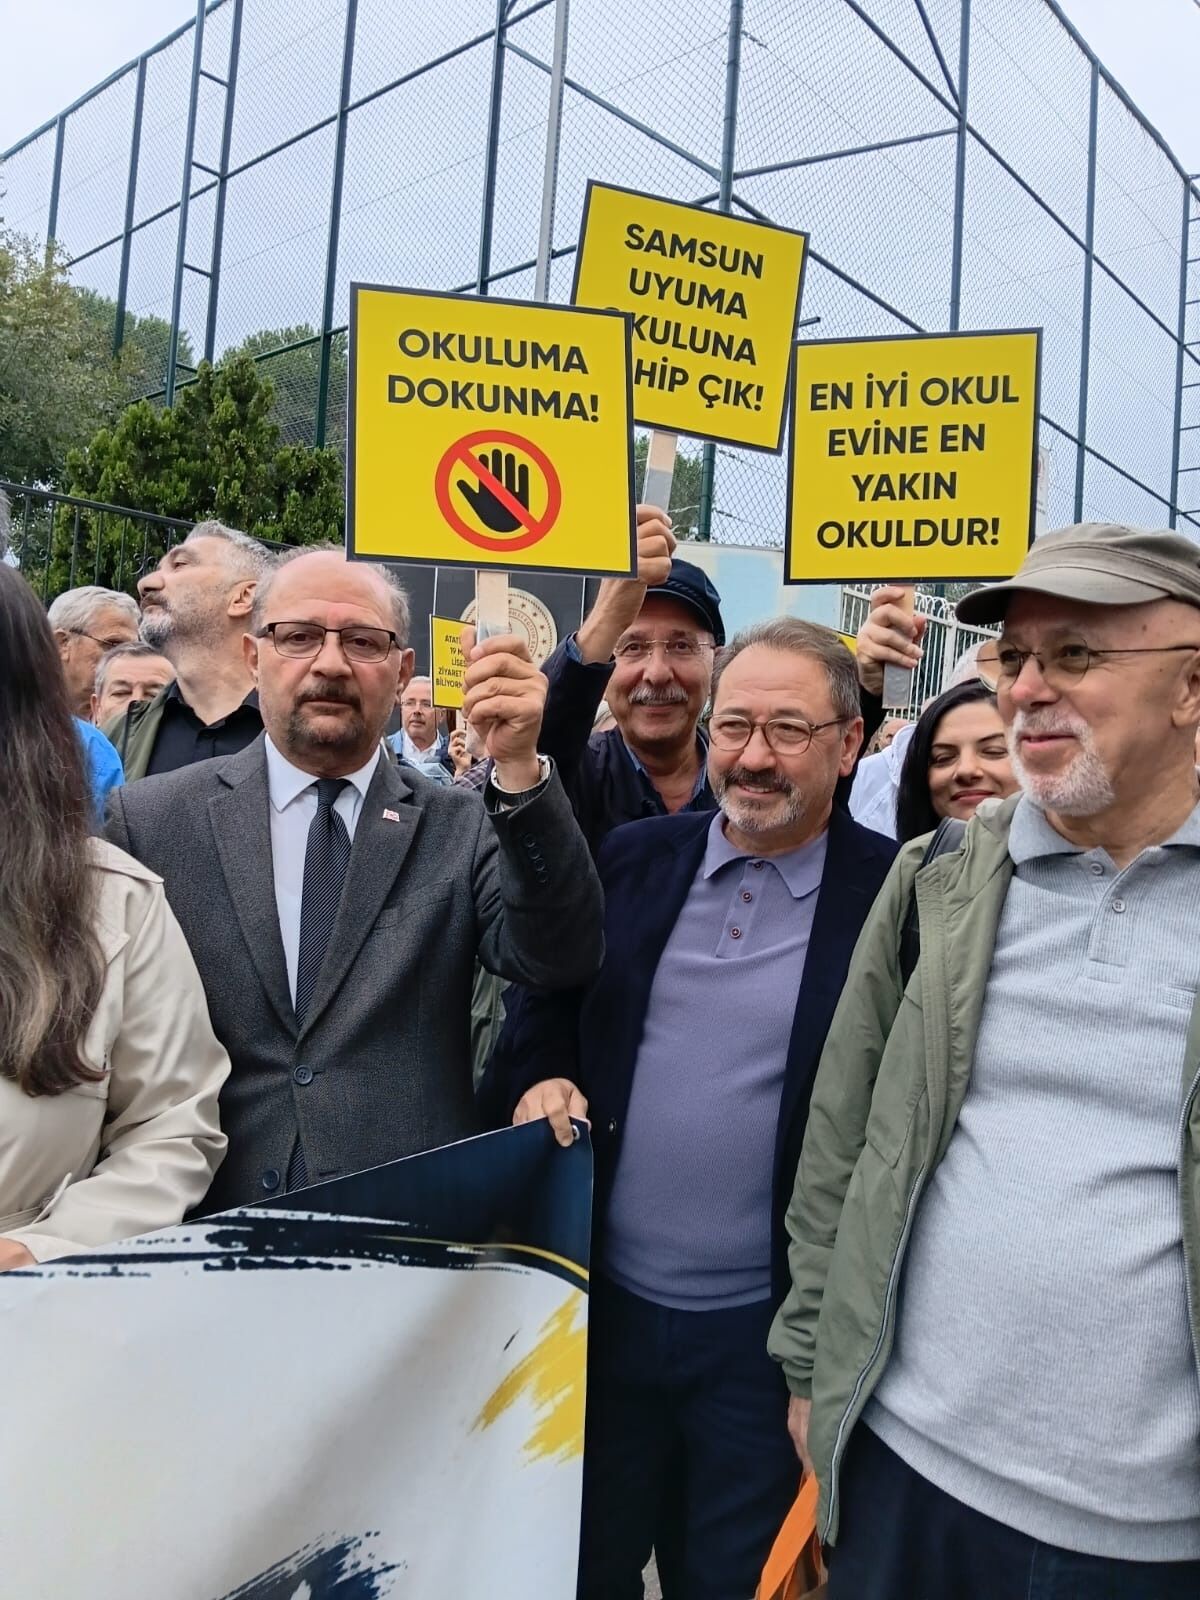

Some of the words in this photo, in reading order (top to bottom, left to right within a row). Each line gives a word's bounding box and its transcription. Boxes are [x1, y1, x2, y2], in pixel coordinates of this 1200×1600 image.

[625, 224, 763, 279] SAMSUN
[630, 268, 747, 319] UYUMA
[399, 329, 588, 374] OKULUMA
[604, 307, 757, 366] KULUNA
[388, 375, 598, 422] DOKUNMA!
[634, 356, 690, 392] HİP
[698, 375, 764, 411] ÇIK!
[810, 383, 853, 411] EN
[865, 371, 909, 409] İYİ
[920, 375, 1020, 406] OKUL
[828, 419, 929, 457] EVİNE
[940, 424, 986, 453] EN
[852, 472, 957, 501] YAKIN
[816, 518, 1000, 549] OKULDUR!
[438, 665, 462, 677] ZİYARET
